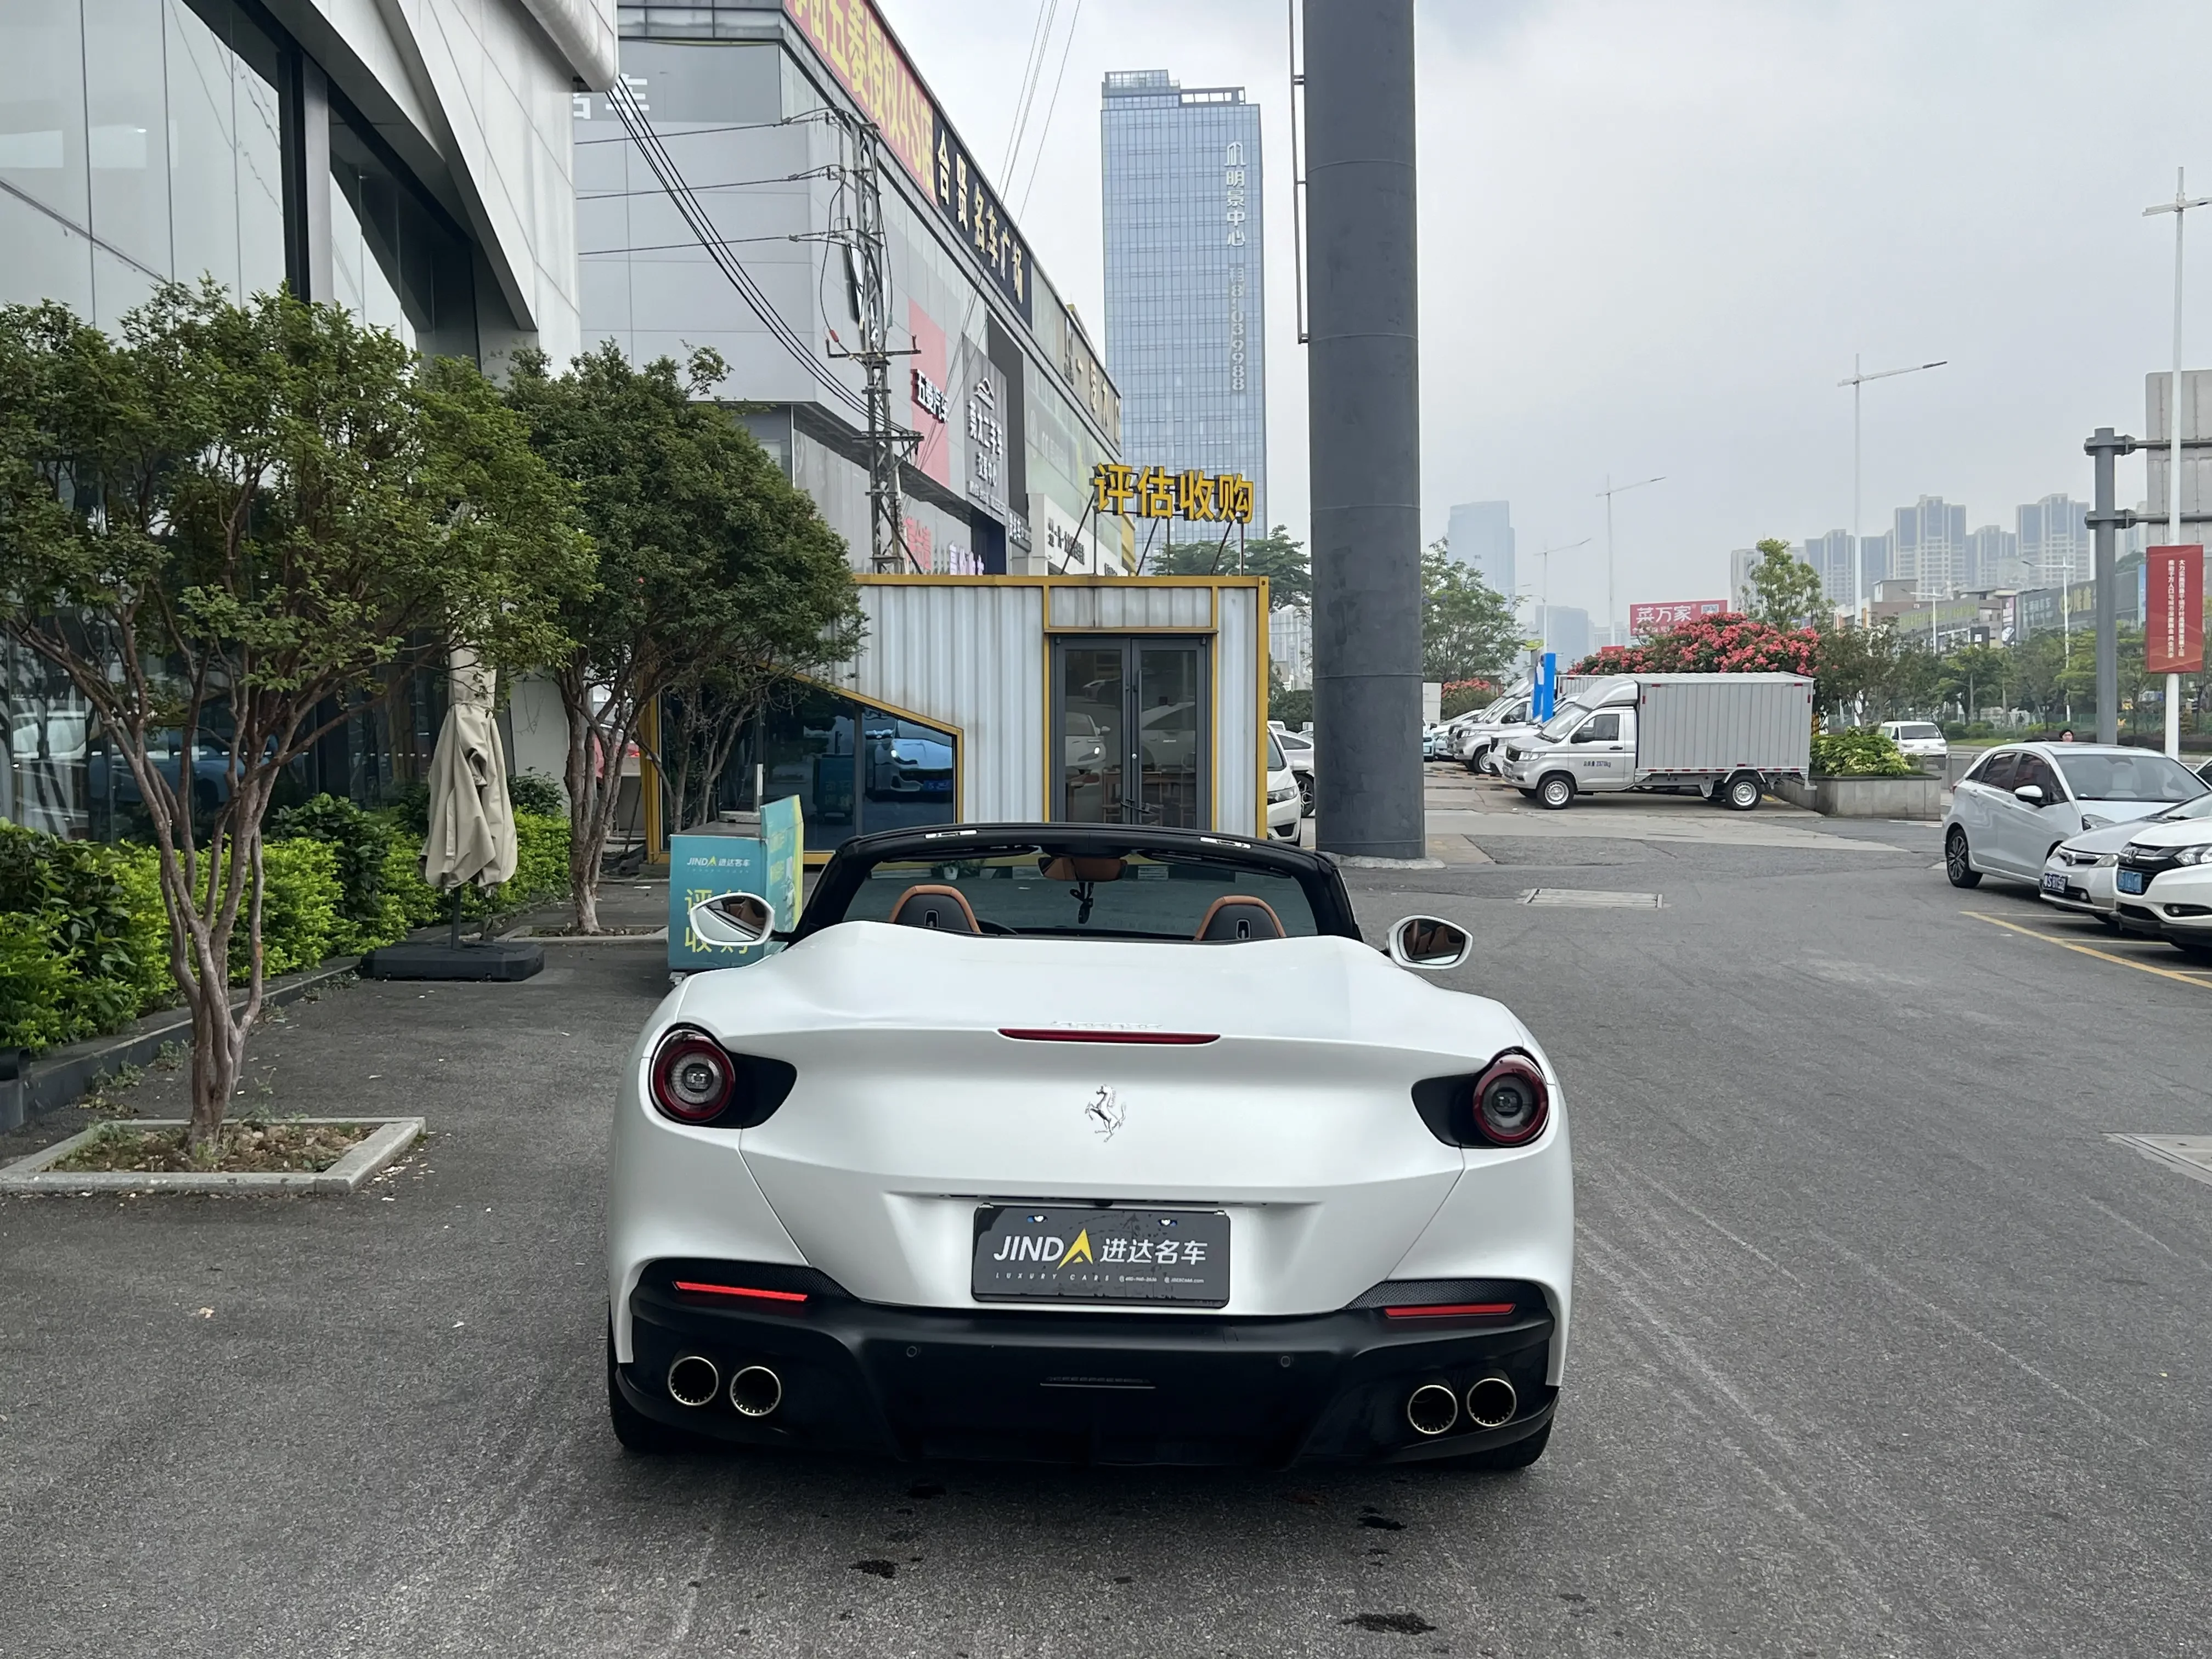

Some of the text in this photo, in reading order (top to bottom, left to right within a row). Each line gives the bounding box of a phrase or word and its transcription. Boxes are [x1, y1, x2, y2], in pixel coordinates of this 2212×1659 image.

[794, 0, 933, 194] 国五菱授权4S店
[1226, 171, 1245, 246] 明景中心
[1094, 462, 1254, 523] 评估收购
[1636, 605, 1692, 624] 菜万家
[687, 856, 716, 867] JINDA
[993, 1227, 1208, 1270] JINDA 进达名车
[996, 1272, 1057, 1280] LUXURY
